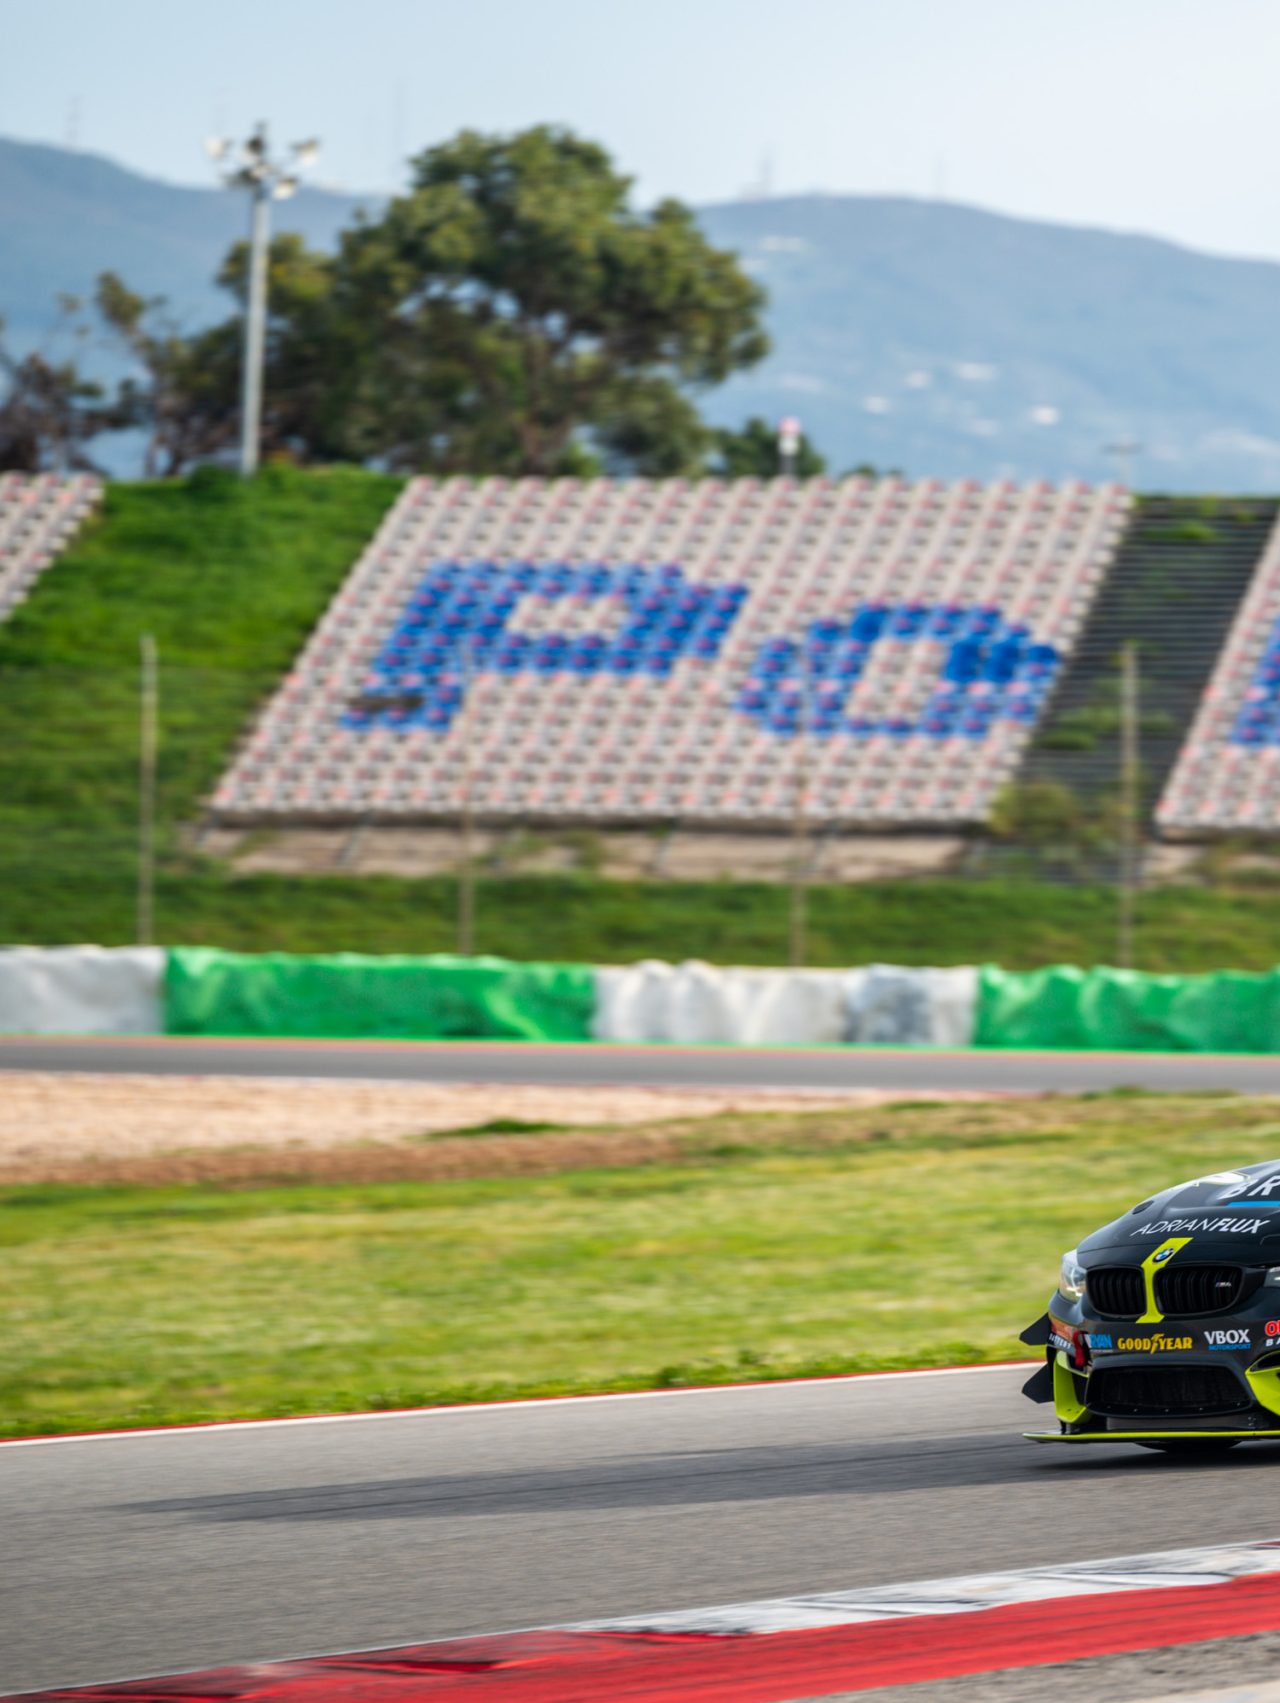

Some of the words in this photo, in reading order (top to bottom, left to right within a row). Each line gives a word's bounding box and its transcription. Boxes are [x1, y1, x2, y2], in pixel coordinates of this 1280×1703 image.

[1130, 1217, 1272, 1237] ADRIANFLUX
[1117, 1333, 1193, 1355] GOODYEAR
[1204, 1329, 1250, 1345] VBOX
